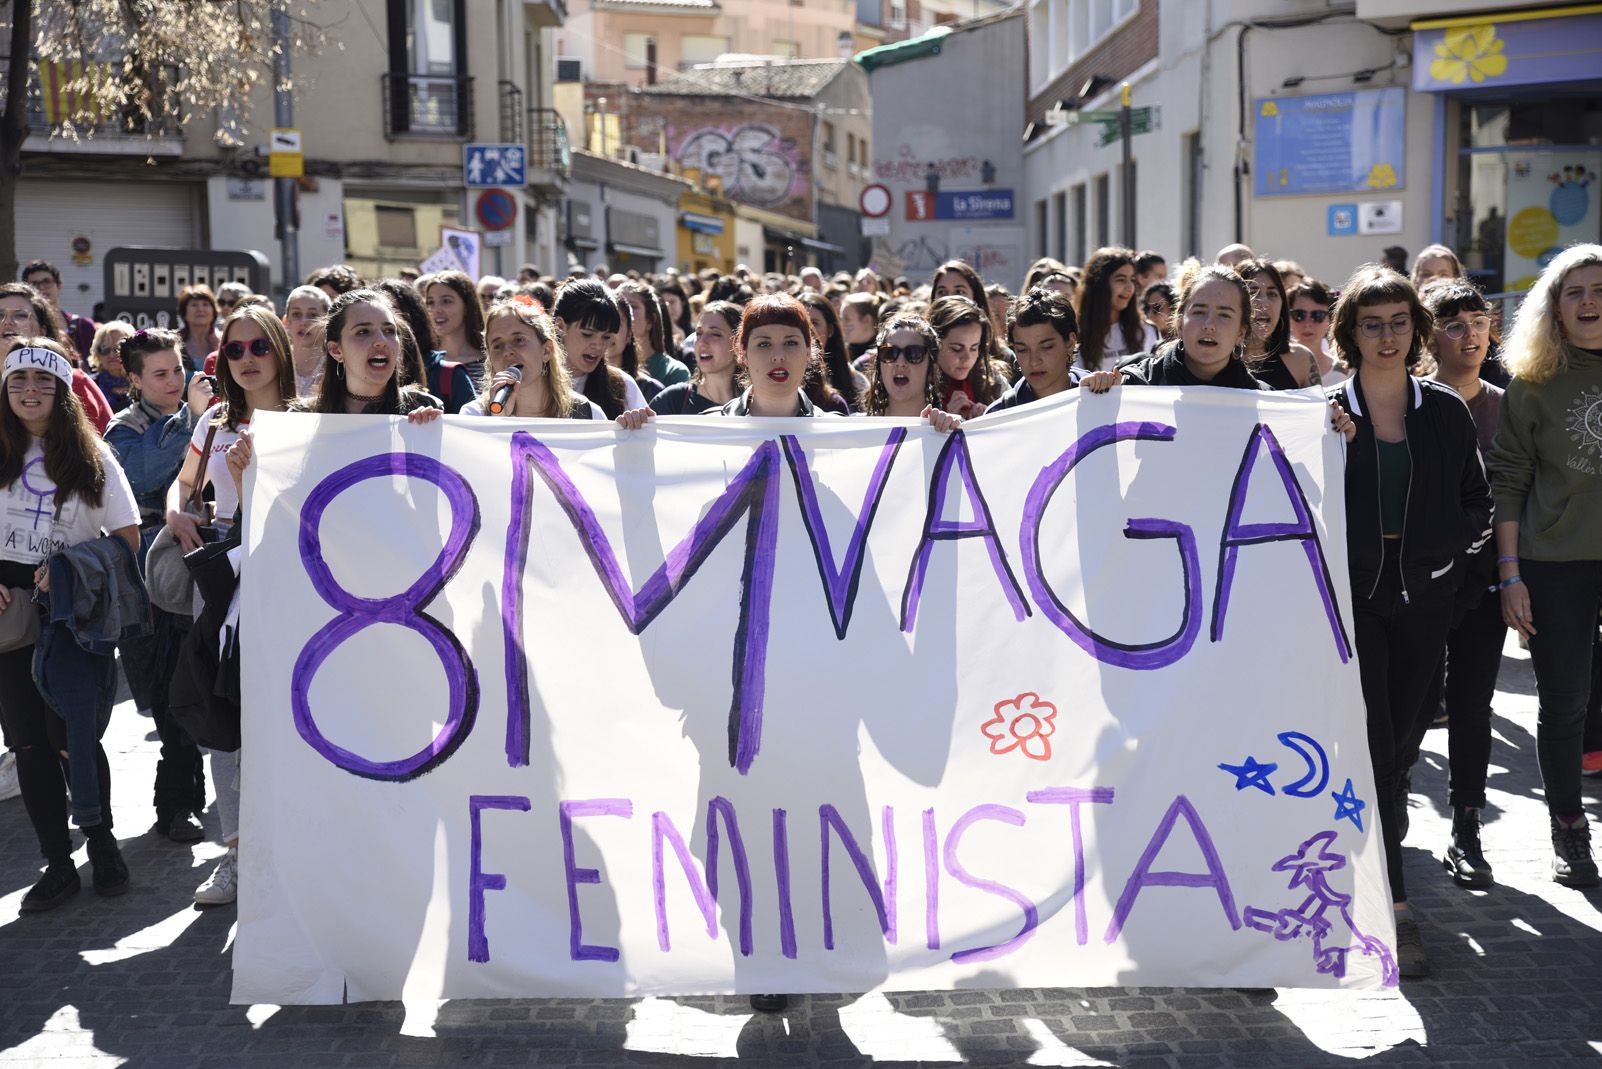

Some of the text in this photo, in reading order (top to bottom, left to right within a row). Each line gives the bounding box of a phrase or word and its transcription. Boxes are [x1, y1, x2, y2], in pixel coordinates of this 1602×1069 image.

[967, 195, 1012, 211] Sirena
[19, 348, 58, 372] PWR
[5, 530, 16, 549] A
[28, 535, 70, 554] WOMA
[779, 421, 1353, 671] VAGA
[467, 786, 1242, 964] FEMINISTA
